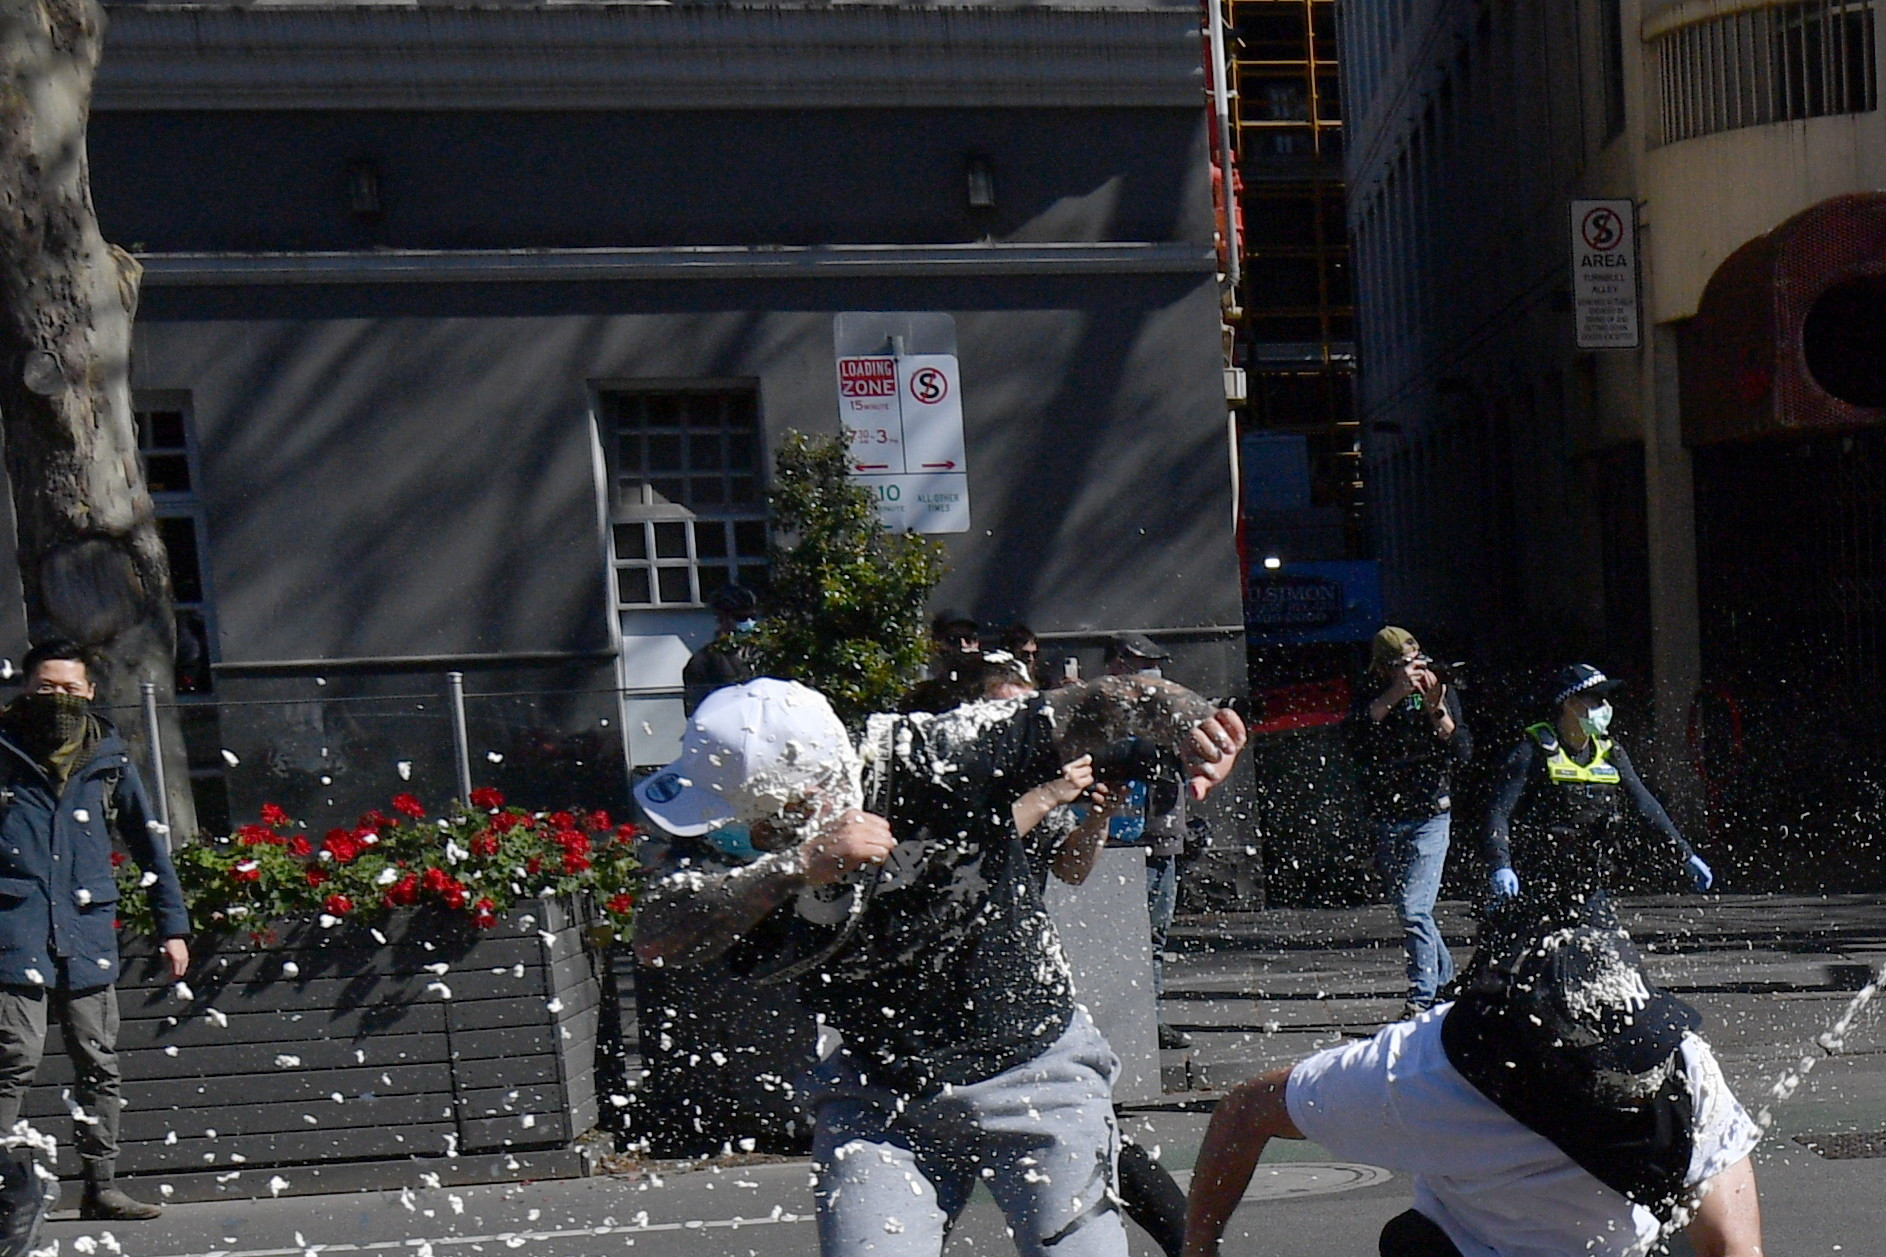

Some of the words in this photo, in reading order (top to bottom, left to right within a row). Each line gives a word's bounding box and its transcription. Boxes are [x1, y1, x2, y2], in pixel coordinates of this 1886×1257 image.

[1581, 254, 1627, 267] AREA
[841, 361, 892, 377] LOADING
[842, 379, 895, 395] ZONE
[850, 400, 864, 411] 15
[878, 484, 901, 502] 10
[917, 494, 934, 503] ALL
[935, 493, 960, 503] OTHER
[927, 504, 951, 513] TIMES
